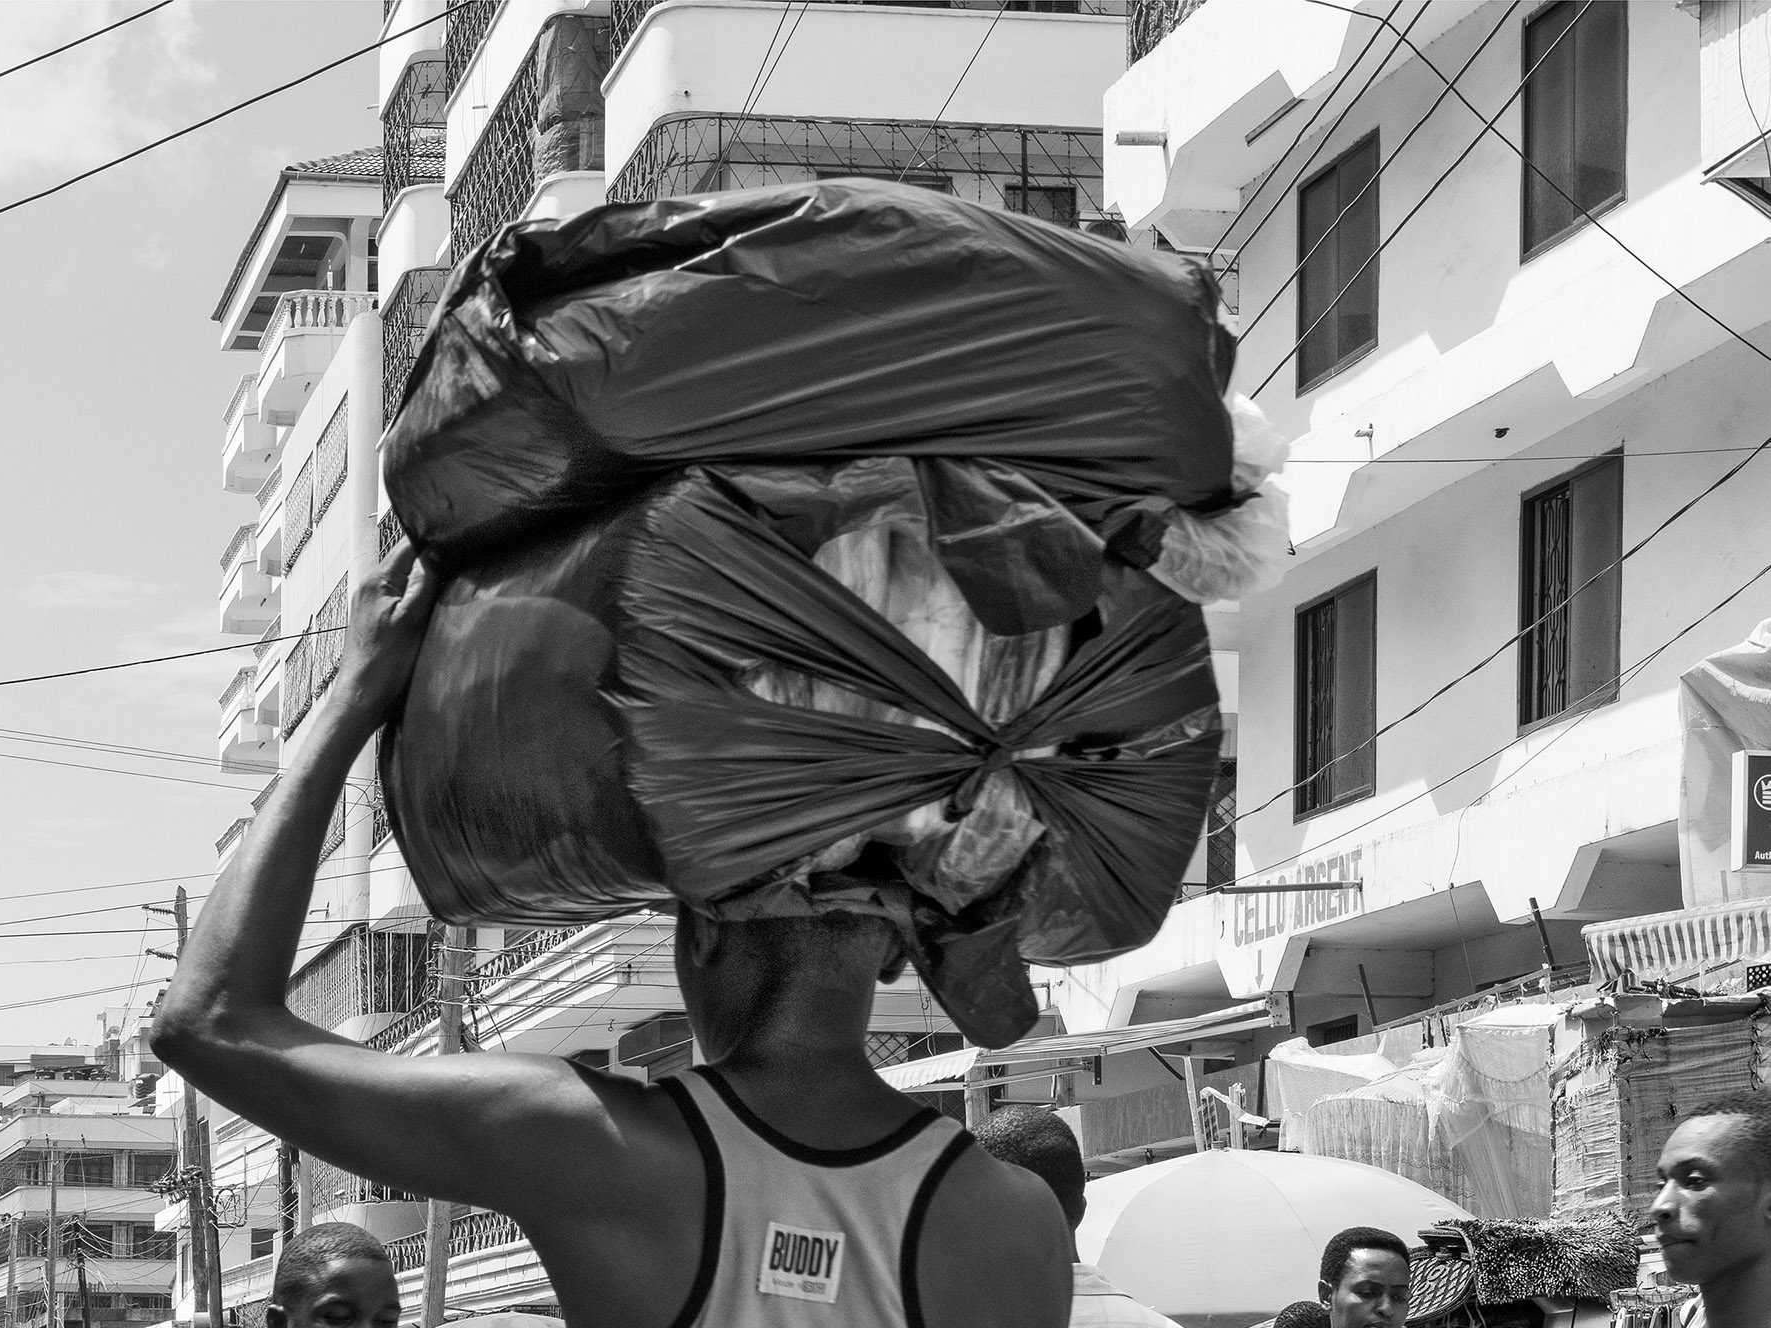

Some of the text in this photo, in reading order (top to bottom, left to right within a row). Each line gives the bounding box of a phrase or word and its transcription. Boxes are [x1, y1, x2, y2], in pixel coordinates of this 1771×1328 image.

[1234, 844, 1363, 948] CELLO ARGENT
[769, 1230, 839, 1279] BUDDY
